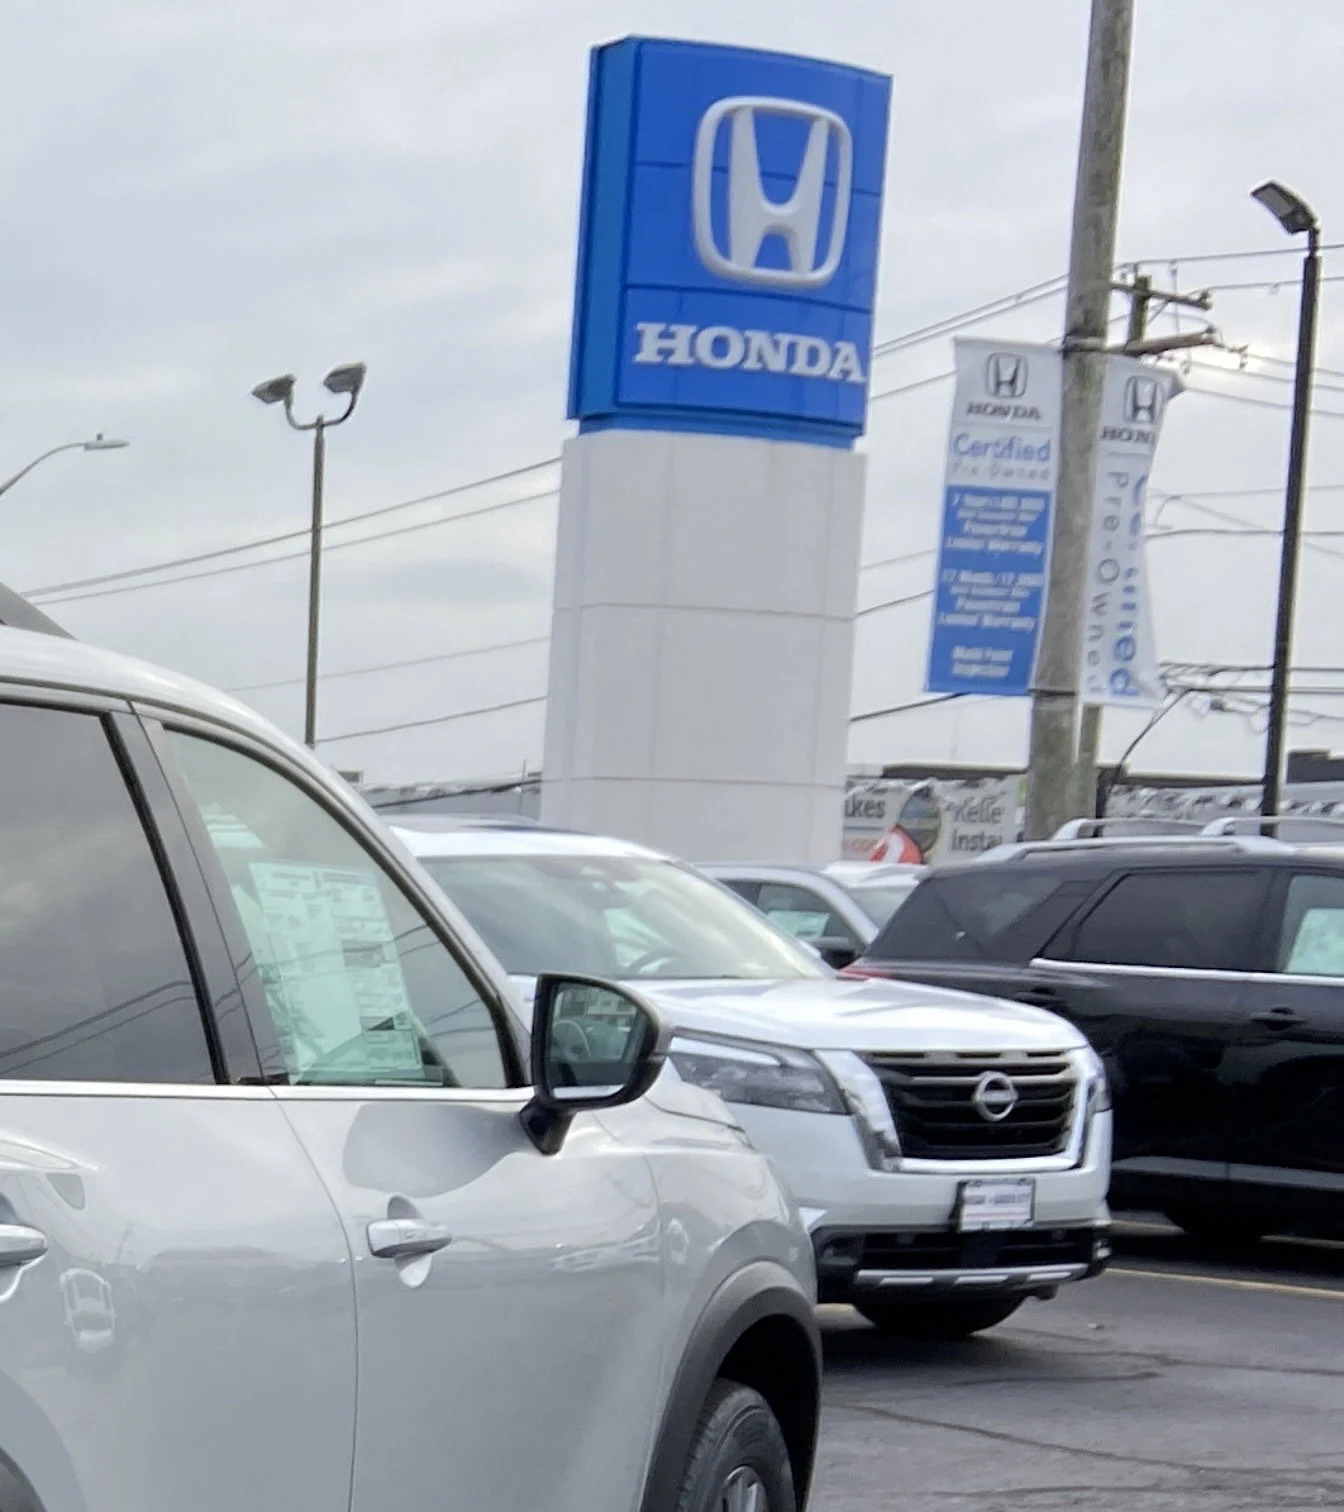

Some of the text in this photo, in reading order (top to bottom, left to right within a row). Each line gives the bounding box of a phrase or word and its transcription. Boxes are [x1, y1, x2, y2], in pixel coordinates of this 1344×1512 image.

[633, 321, 868, 384] HONDA
[966, 401, 1041, 420] HONDA
[1101, 424, 1156, 445] HON
